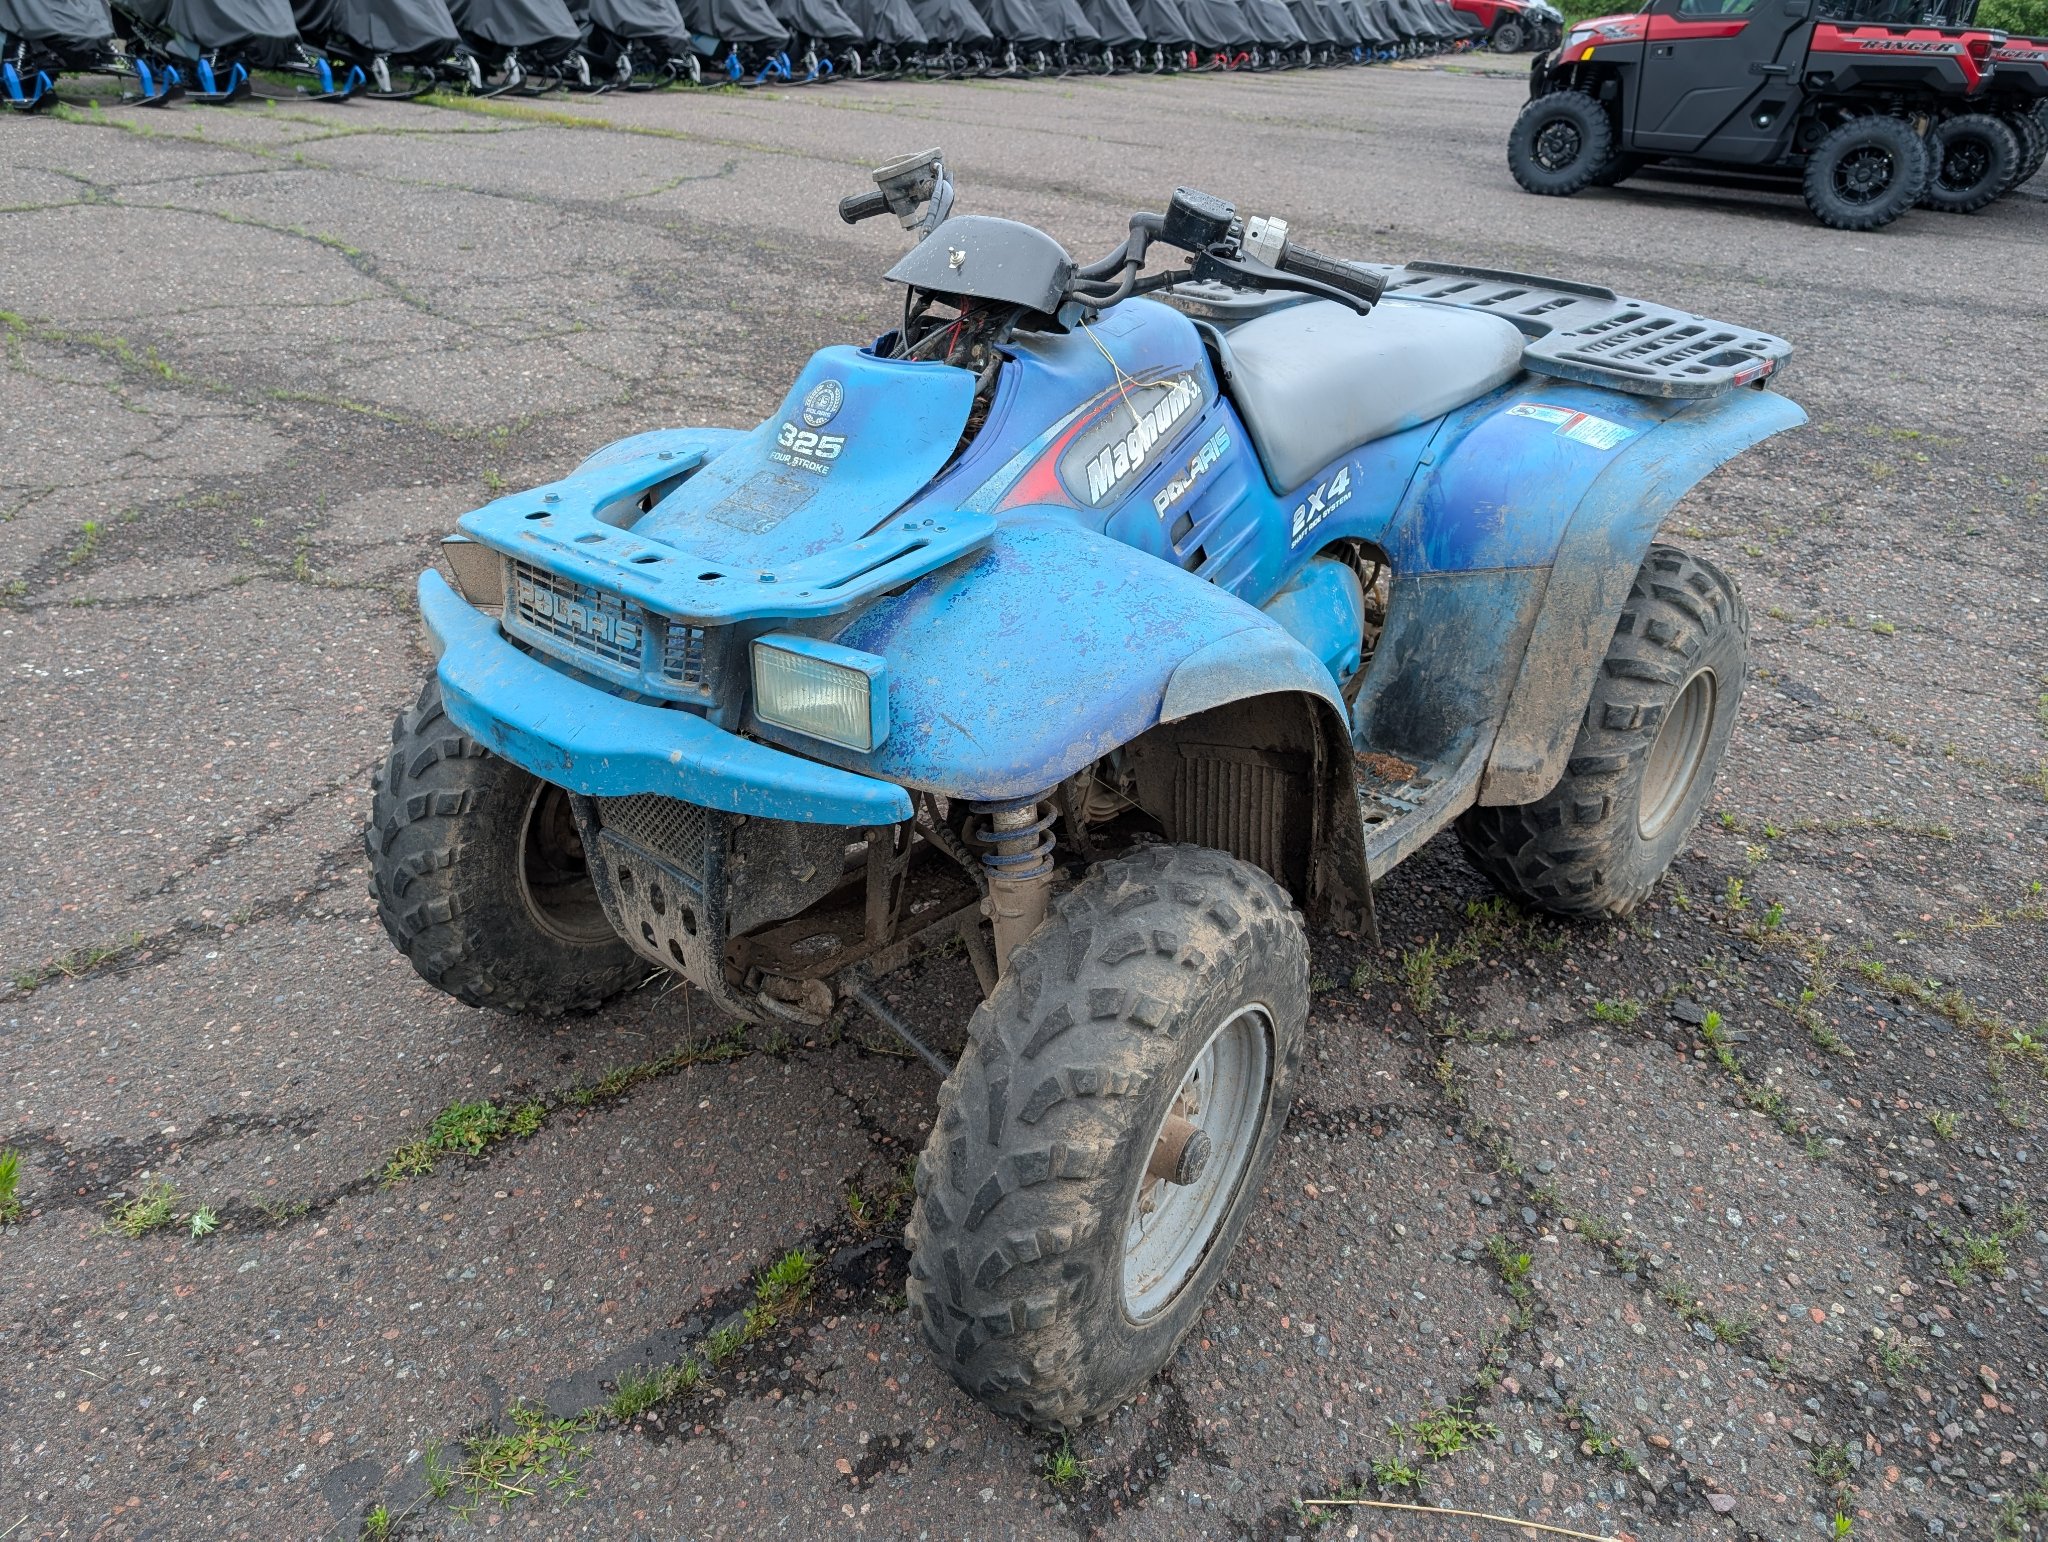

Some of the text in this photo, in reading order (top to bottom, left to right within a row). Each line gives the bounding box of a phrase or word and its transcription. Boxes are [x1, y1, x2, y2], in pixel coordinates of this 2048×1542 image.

[1860, 40, 1955, 53] RANGER
[777, 422, 846, 459] 325
[1086, 378, 1192, 506] Magnum
[769, 451, 831, 476] FOUR STROKE
[1153, 425, 1231, 519] POLARIS
[1322, 491, 1352, 519] SYSTEM
[518, 579, 638, 651] POLARIS
